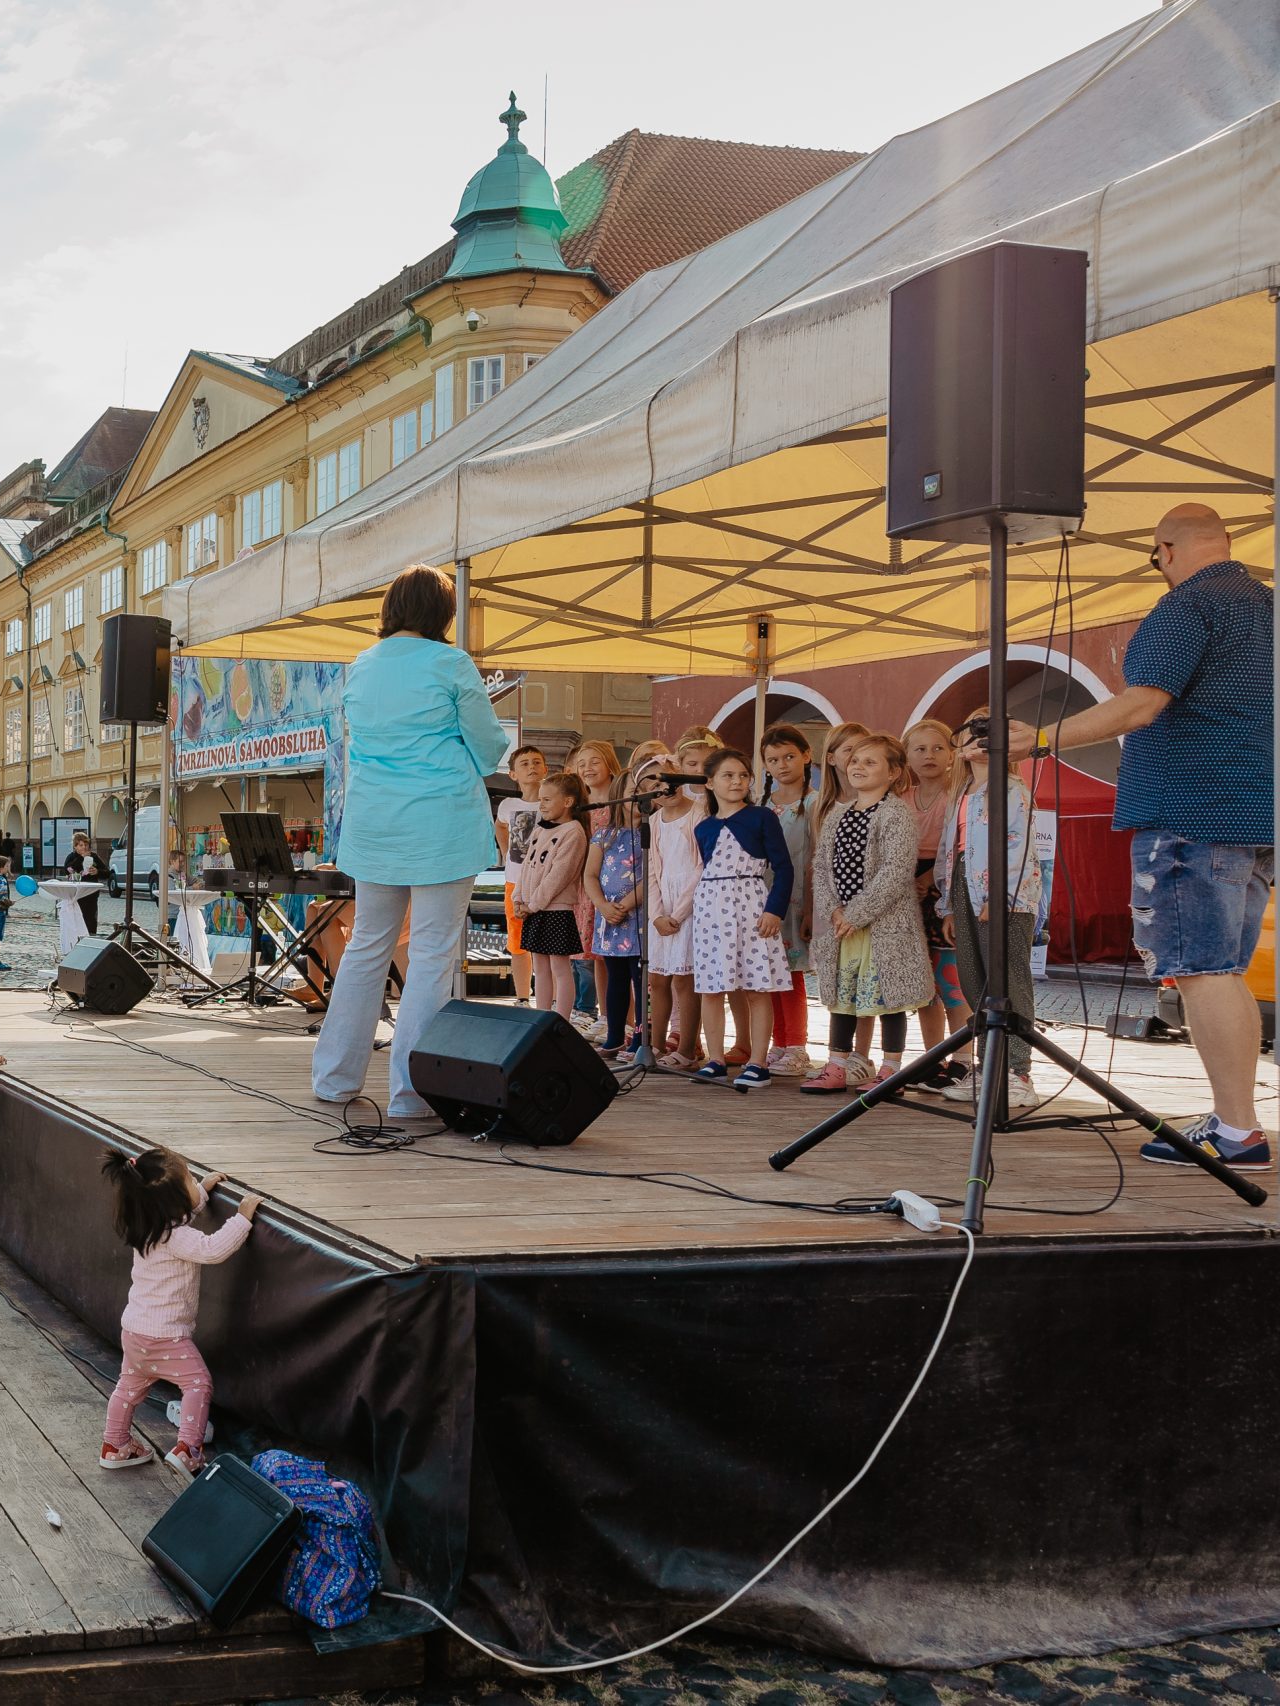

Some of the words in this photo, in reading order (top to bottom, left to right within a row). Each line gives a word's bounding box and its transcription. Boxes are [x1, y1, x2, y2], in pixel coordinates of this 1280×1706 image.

[178, 741, 237, 772] ZMRZLINOVÁ
[239, 728, 326, 762] SAMOOBSLUHA
[248, 881, 269, 889] CSIO
